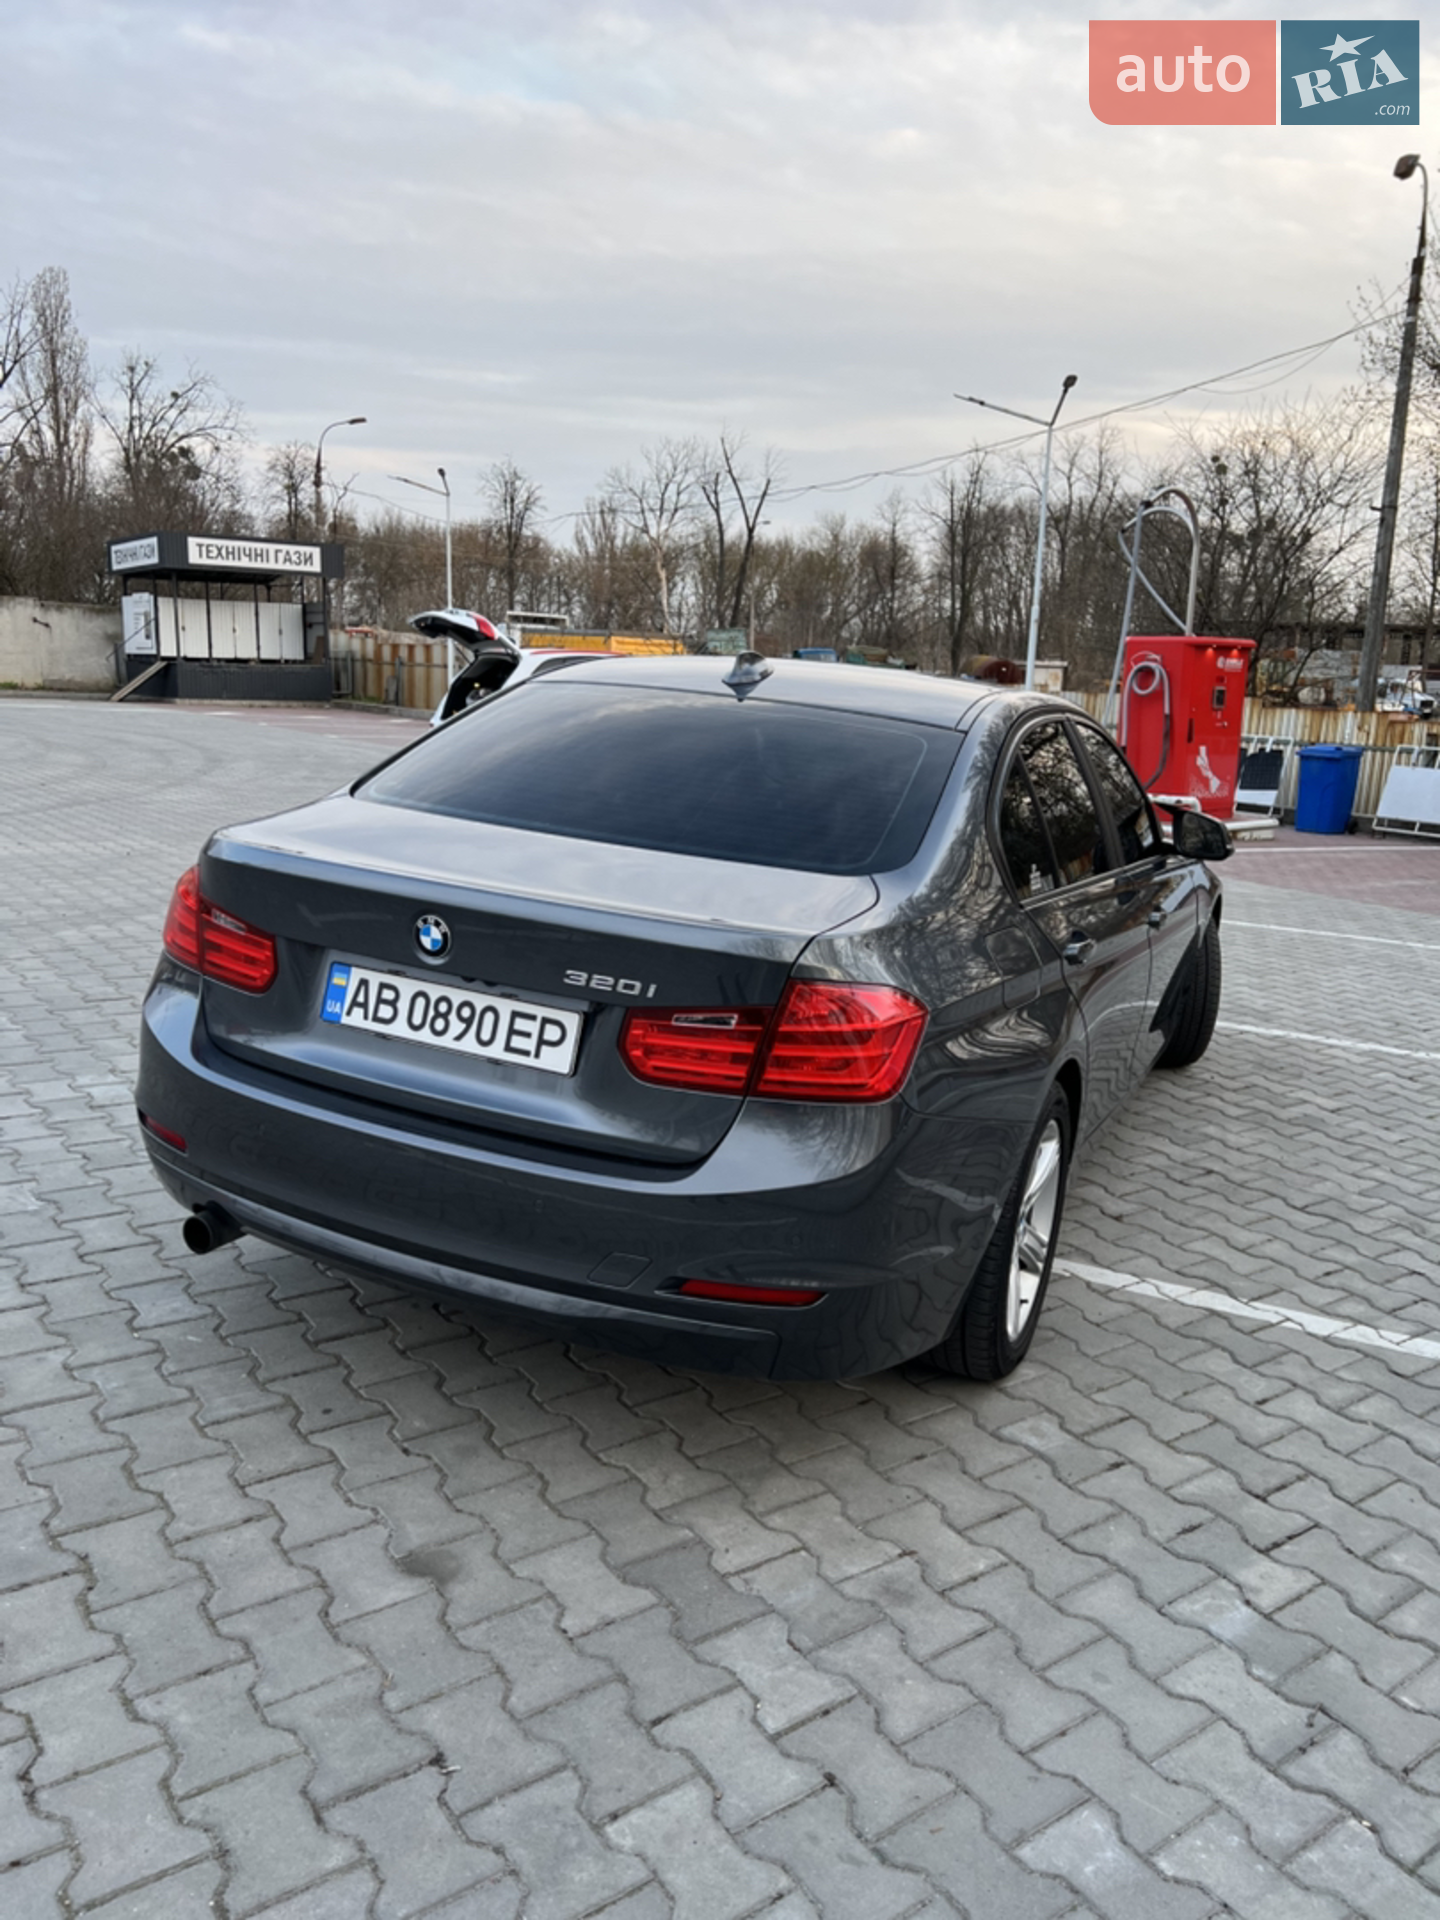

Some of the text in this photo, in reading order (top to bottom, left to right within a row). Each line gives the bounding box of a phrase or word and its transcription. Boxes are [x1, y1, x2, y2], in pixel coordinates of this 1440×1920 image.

[195, 543, 314, 566] ТЕХНІЧНІ ГАЗИ
[326, 1000, 341, 1014] UA
[346, 978, 567, 1059] AB 0890 EP
